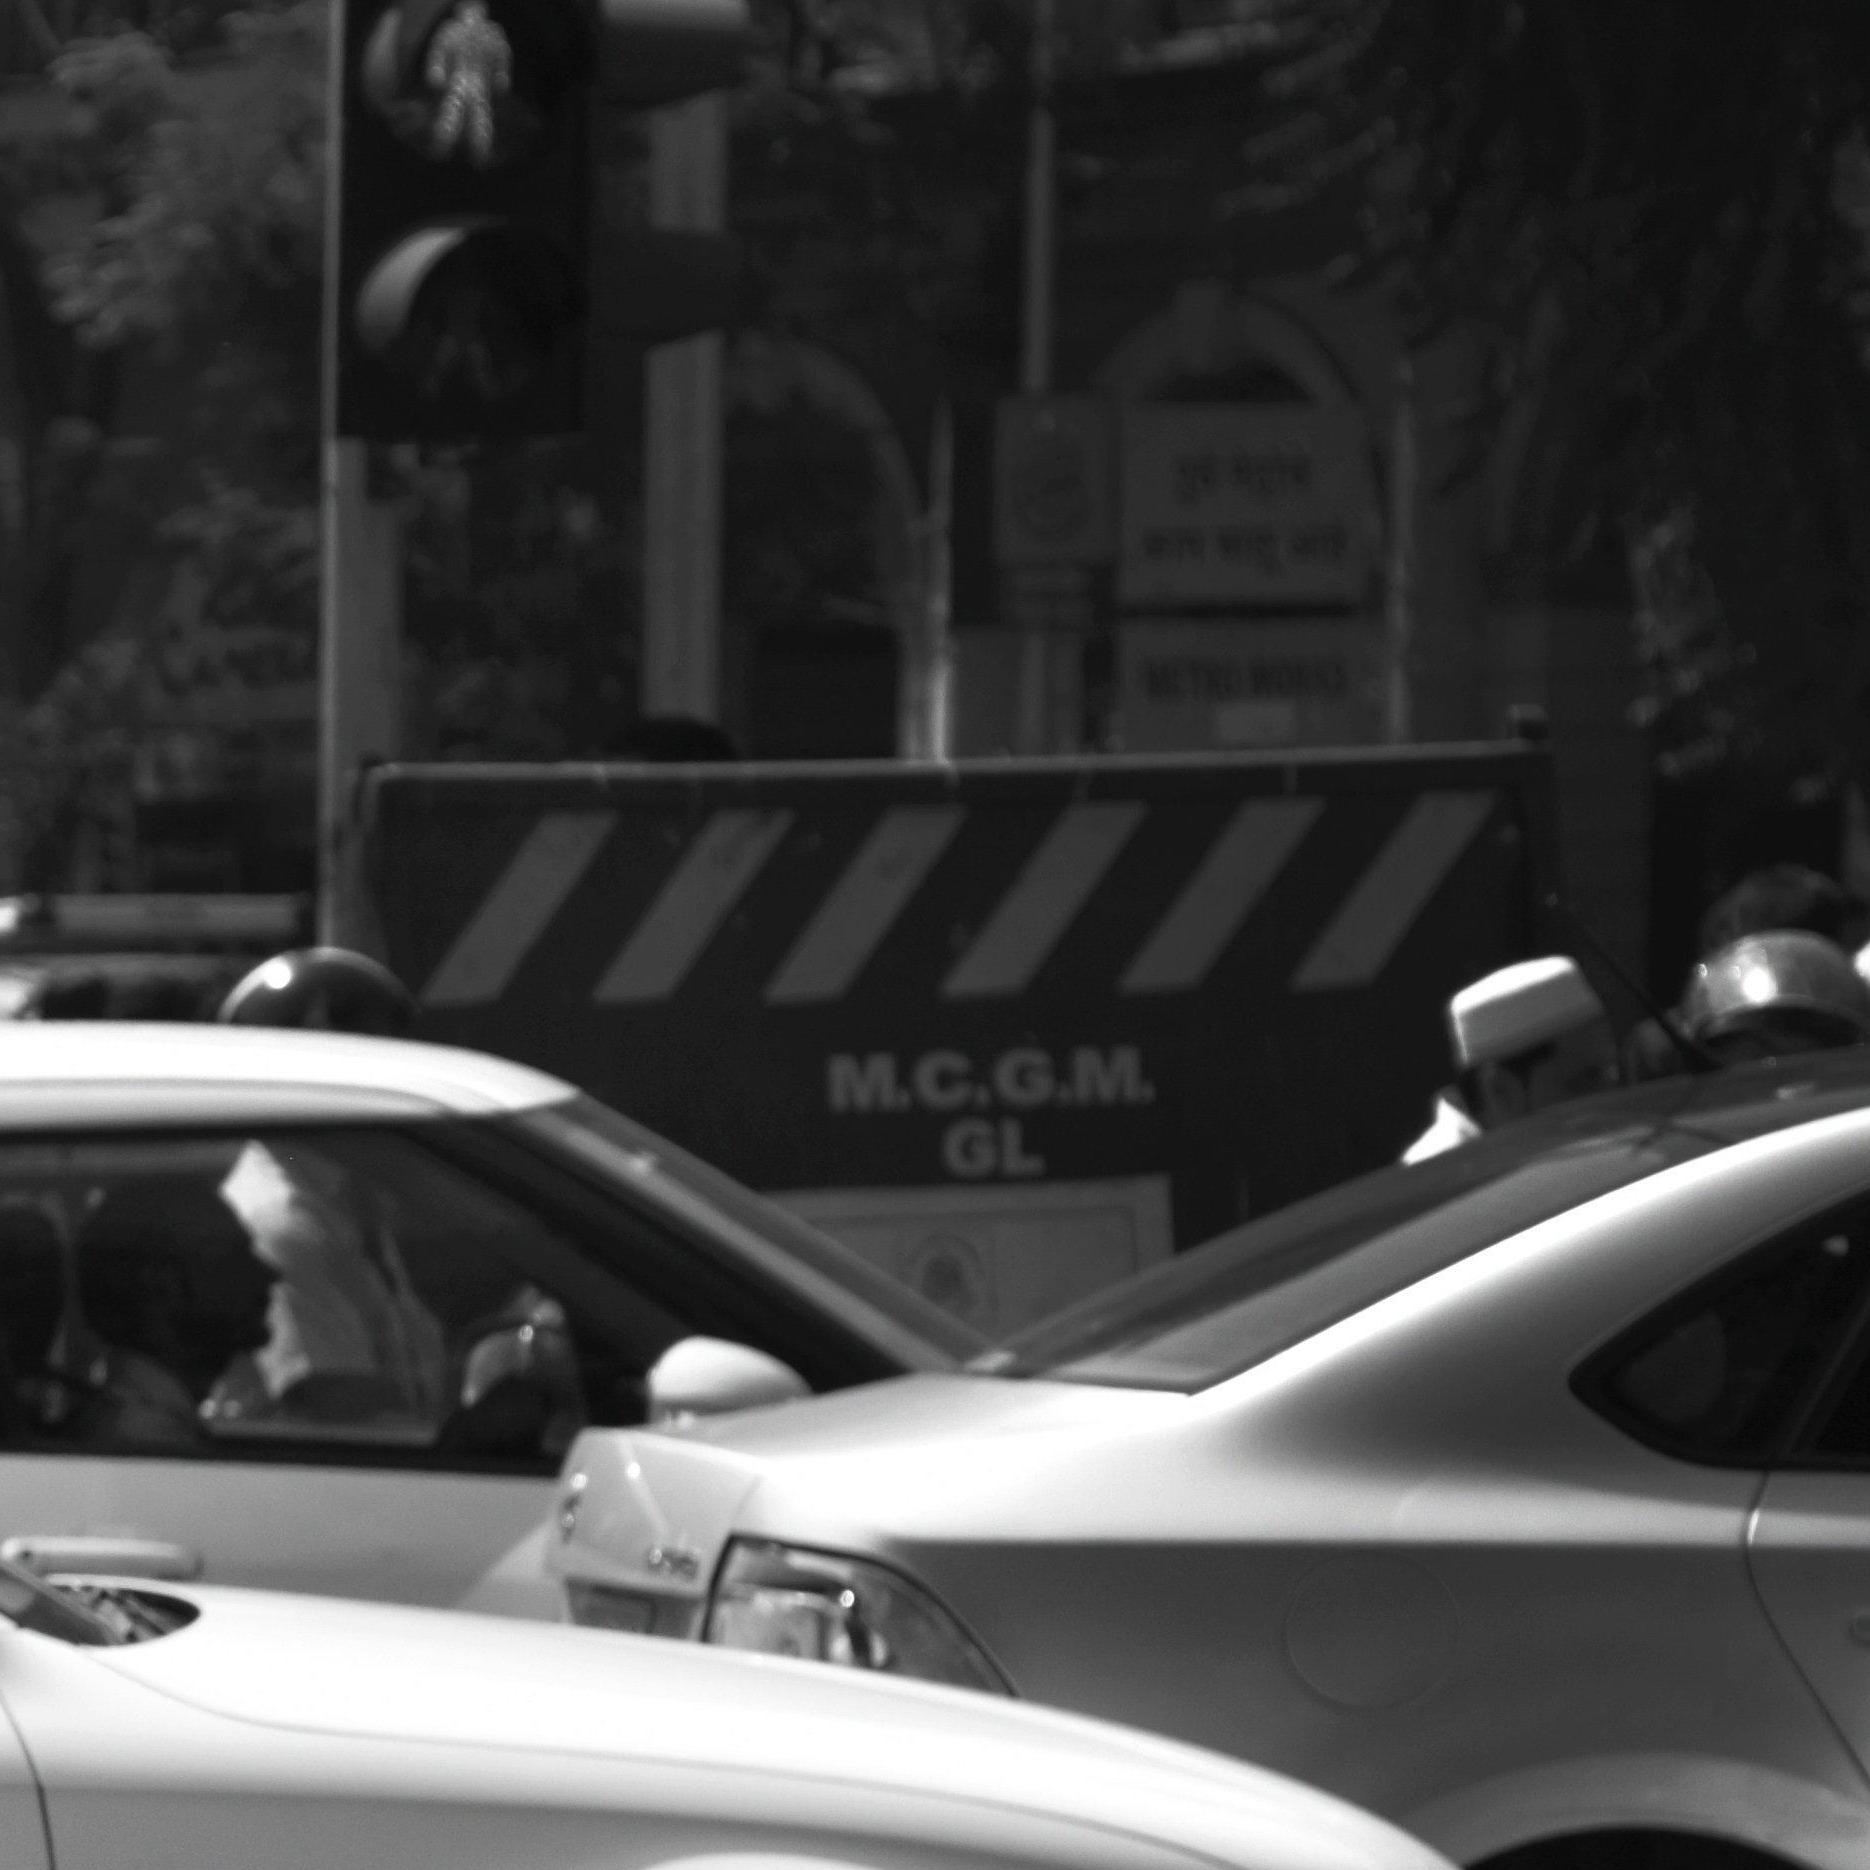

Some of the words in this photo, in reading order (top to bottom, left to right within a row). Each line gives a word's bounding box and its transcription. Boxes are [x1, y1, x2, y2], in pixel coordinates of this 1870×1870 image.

[1143, 656, 1241, 700] METRO
[826, 1044, 1156, 1114] M.C.G.M.
[941, 1117, 1045, 1177] GL
